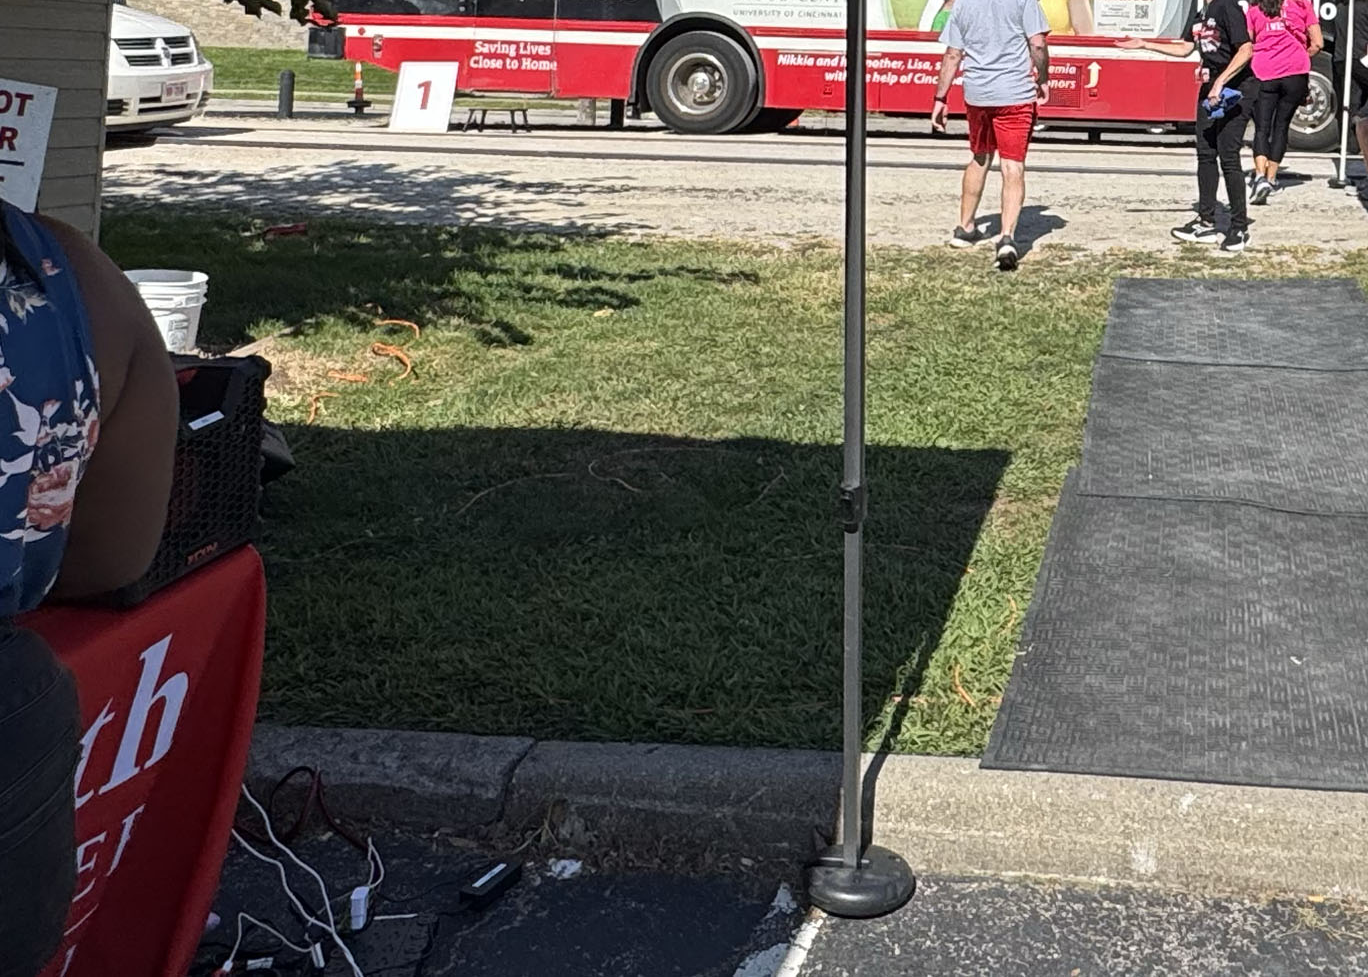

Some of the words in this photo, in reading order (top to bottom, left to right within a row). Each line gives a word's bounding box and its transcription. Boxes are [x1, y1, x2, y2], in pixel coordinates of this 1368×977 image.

[733, 9, 781, 19] UNIVERSITY
[474, 41, 517, 56] Saving
[519, 42, 551, 55] Lives
[470, 58, 502, 70] Close
[505, 59, 518, 70] to
[521, 58, 557, 71] Home
[816, 55, 839, 67] and
[872, 73, 898, 86] help
[900, 73, 913, 84] of
[417, 80, 432, 110] 1
